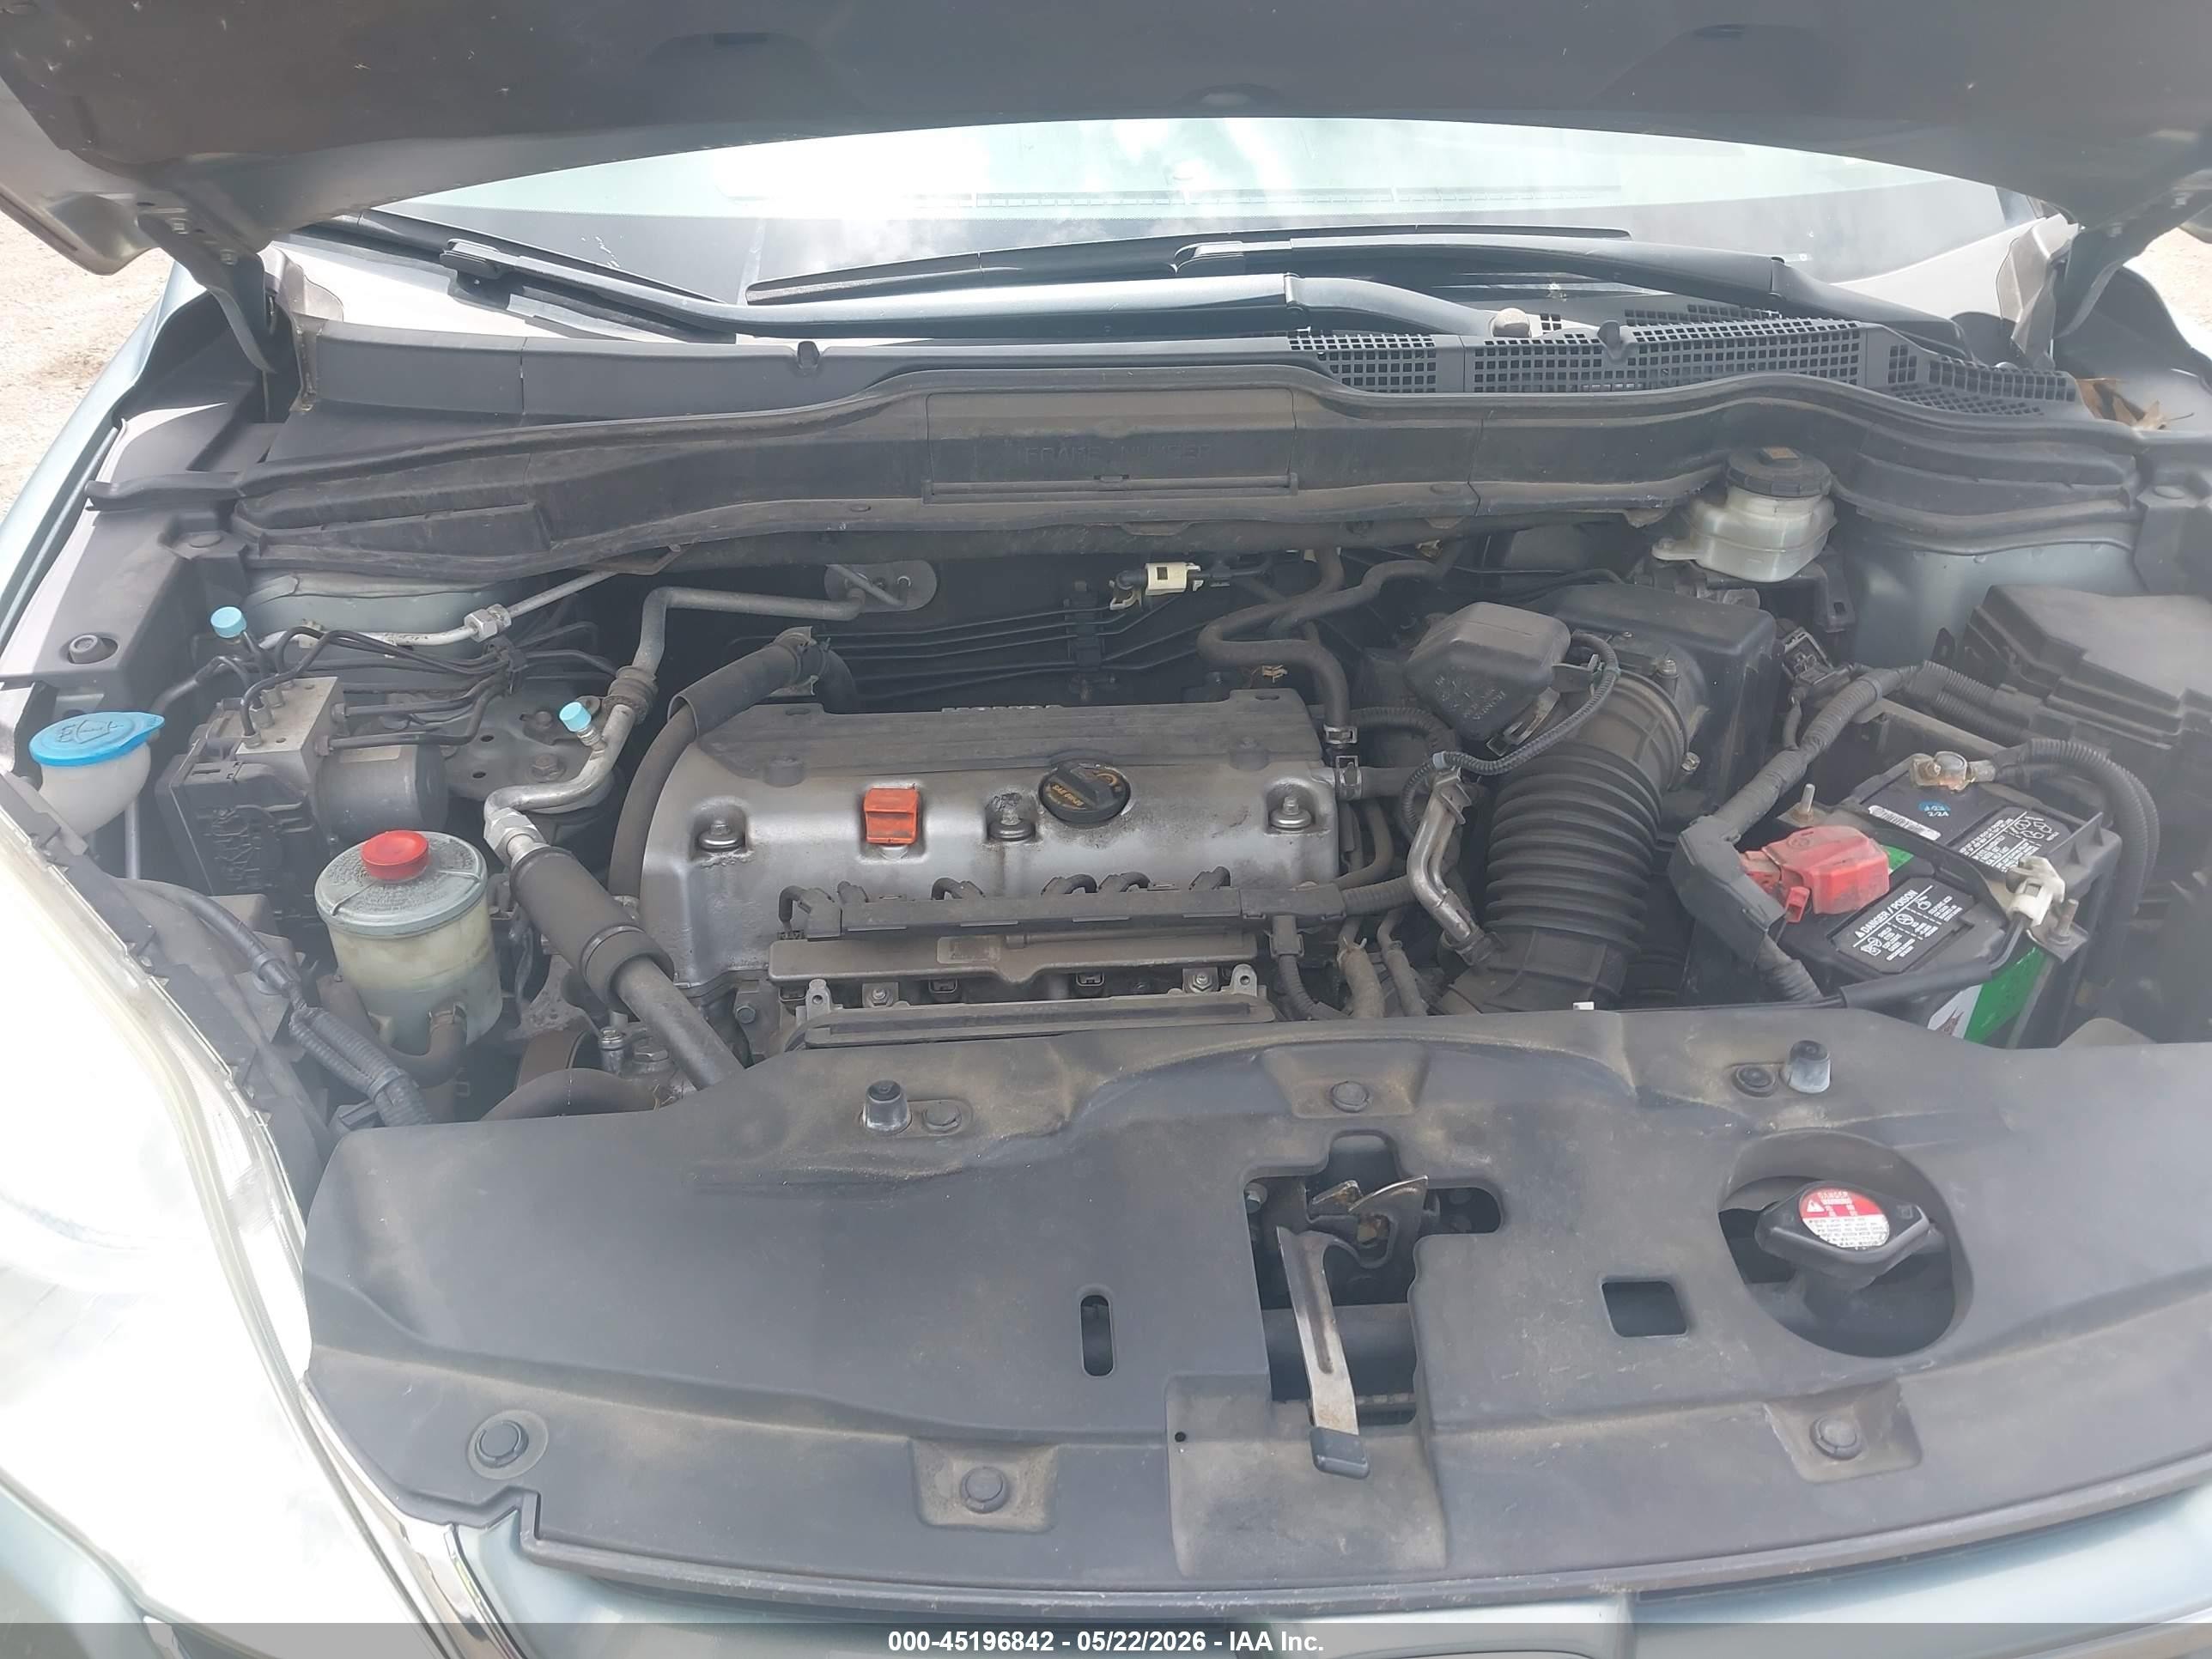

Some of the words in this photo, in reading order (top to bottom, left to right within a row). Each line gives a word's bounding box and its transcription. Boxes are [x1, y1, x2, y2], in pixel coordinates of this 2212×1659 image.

[1023, 445, 1103, 463] FRAME
[1860, 910, 1891, 934] DANGER
[1892, 889, 1919, 910] POISON
